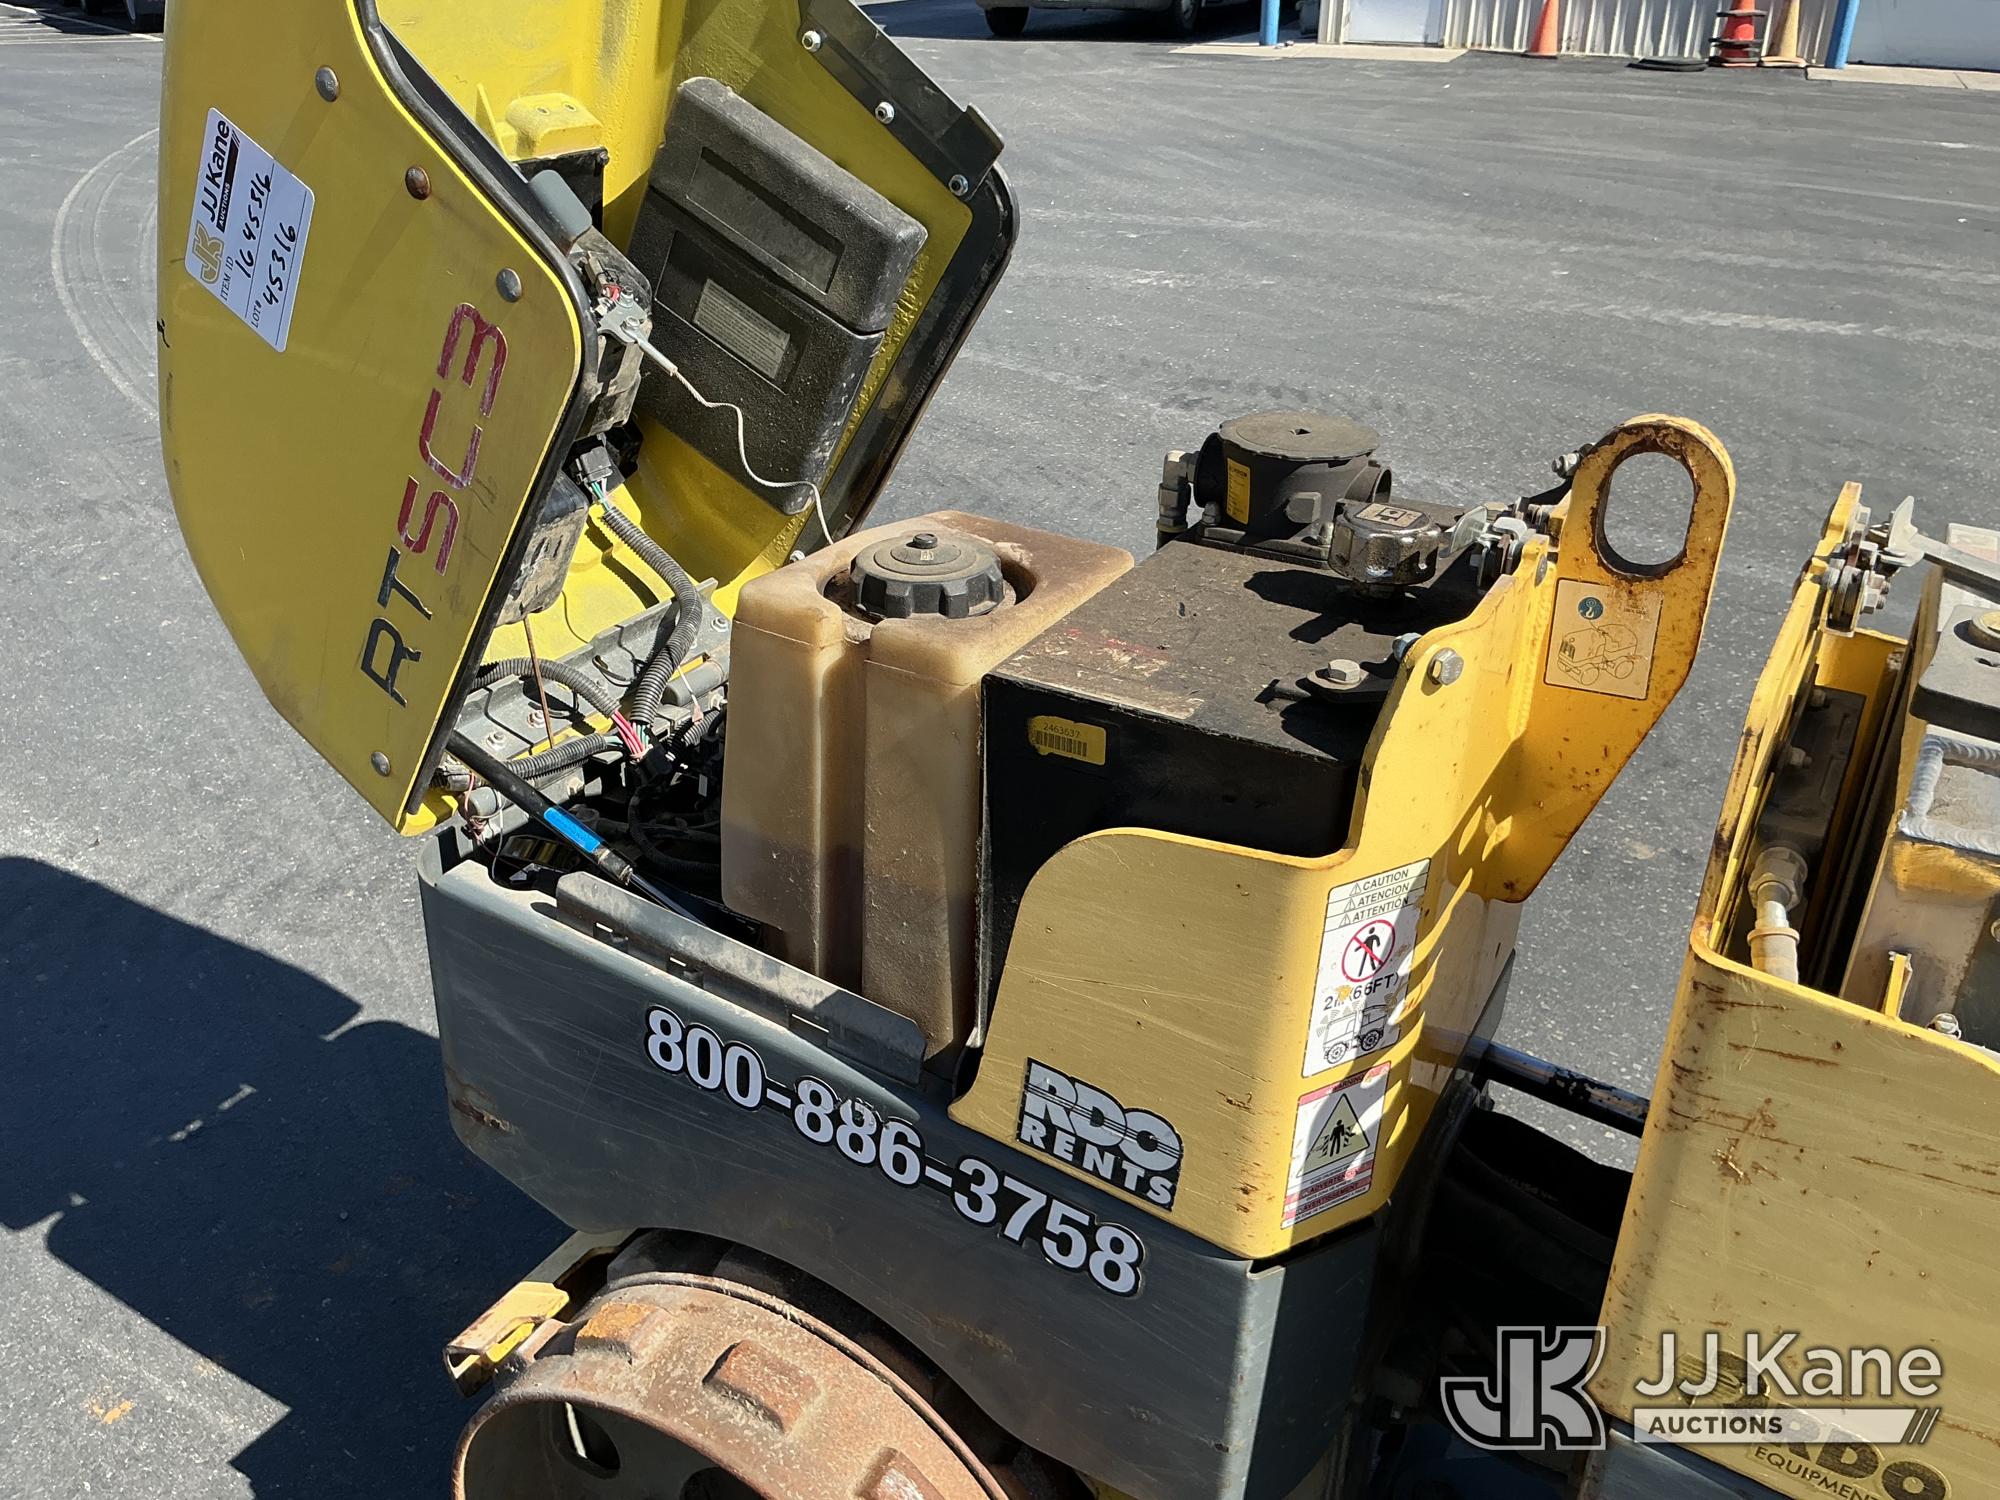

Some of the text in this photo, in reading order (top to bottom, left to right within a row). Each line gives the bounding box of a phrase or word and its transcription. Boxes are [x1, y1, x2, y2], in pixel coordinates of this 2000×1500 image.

[206, 120, 230, 188] Kane
[218, 182, 231, 225] AUCTIONS
[220, 256, 234, 301] ITEM ID
[262, 222, 296, 306] 45316
[360, 302, 508, 708] RTSC3
[1352, 897, 1410, 922] ATTENTION
[1358, 883, 1410, 907] ATENCION
[1363, 869, 1409, 891] CAUTION
[1024, 1062, 1181, 1171] RDO
[647, 1009, 1140, 1294] 800-886-3758
[1020, 1114, 1174, 1204] RENTS
